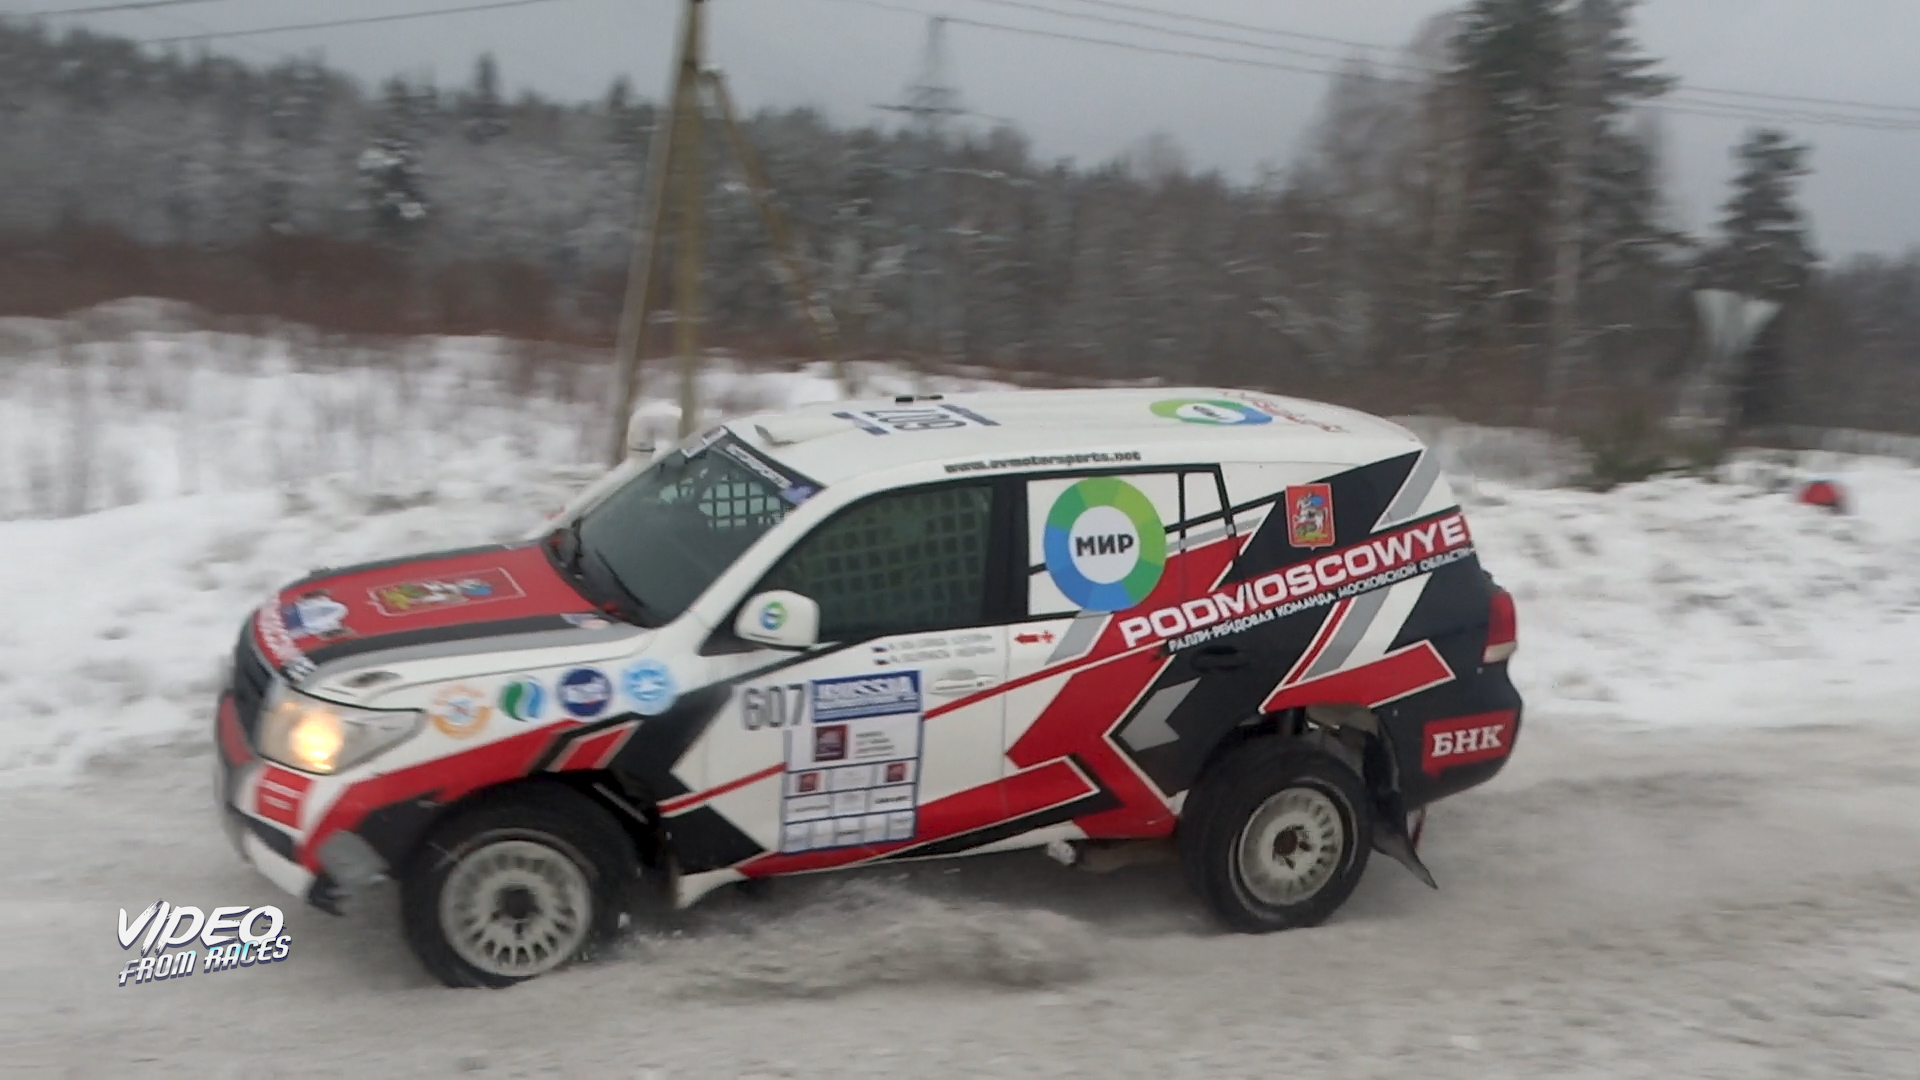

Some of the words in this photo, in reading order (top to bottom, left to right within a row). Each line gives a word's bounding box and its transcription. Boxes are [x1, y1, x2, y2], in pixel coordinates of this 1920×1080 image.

[1075, 534, 1134, 557] МИР
[1118, 515, 1467, 649] PODMOSCOWYE
[1275, 592, 1336, 618] КОМАНДА
[1338, 562, 1418, 598] МОСКОВСКОЙ
[744, 683, 804, 731] 607
[1431, 724, 1505, 757] БНК
